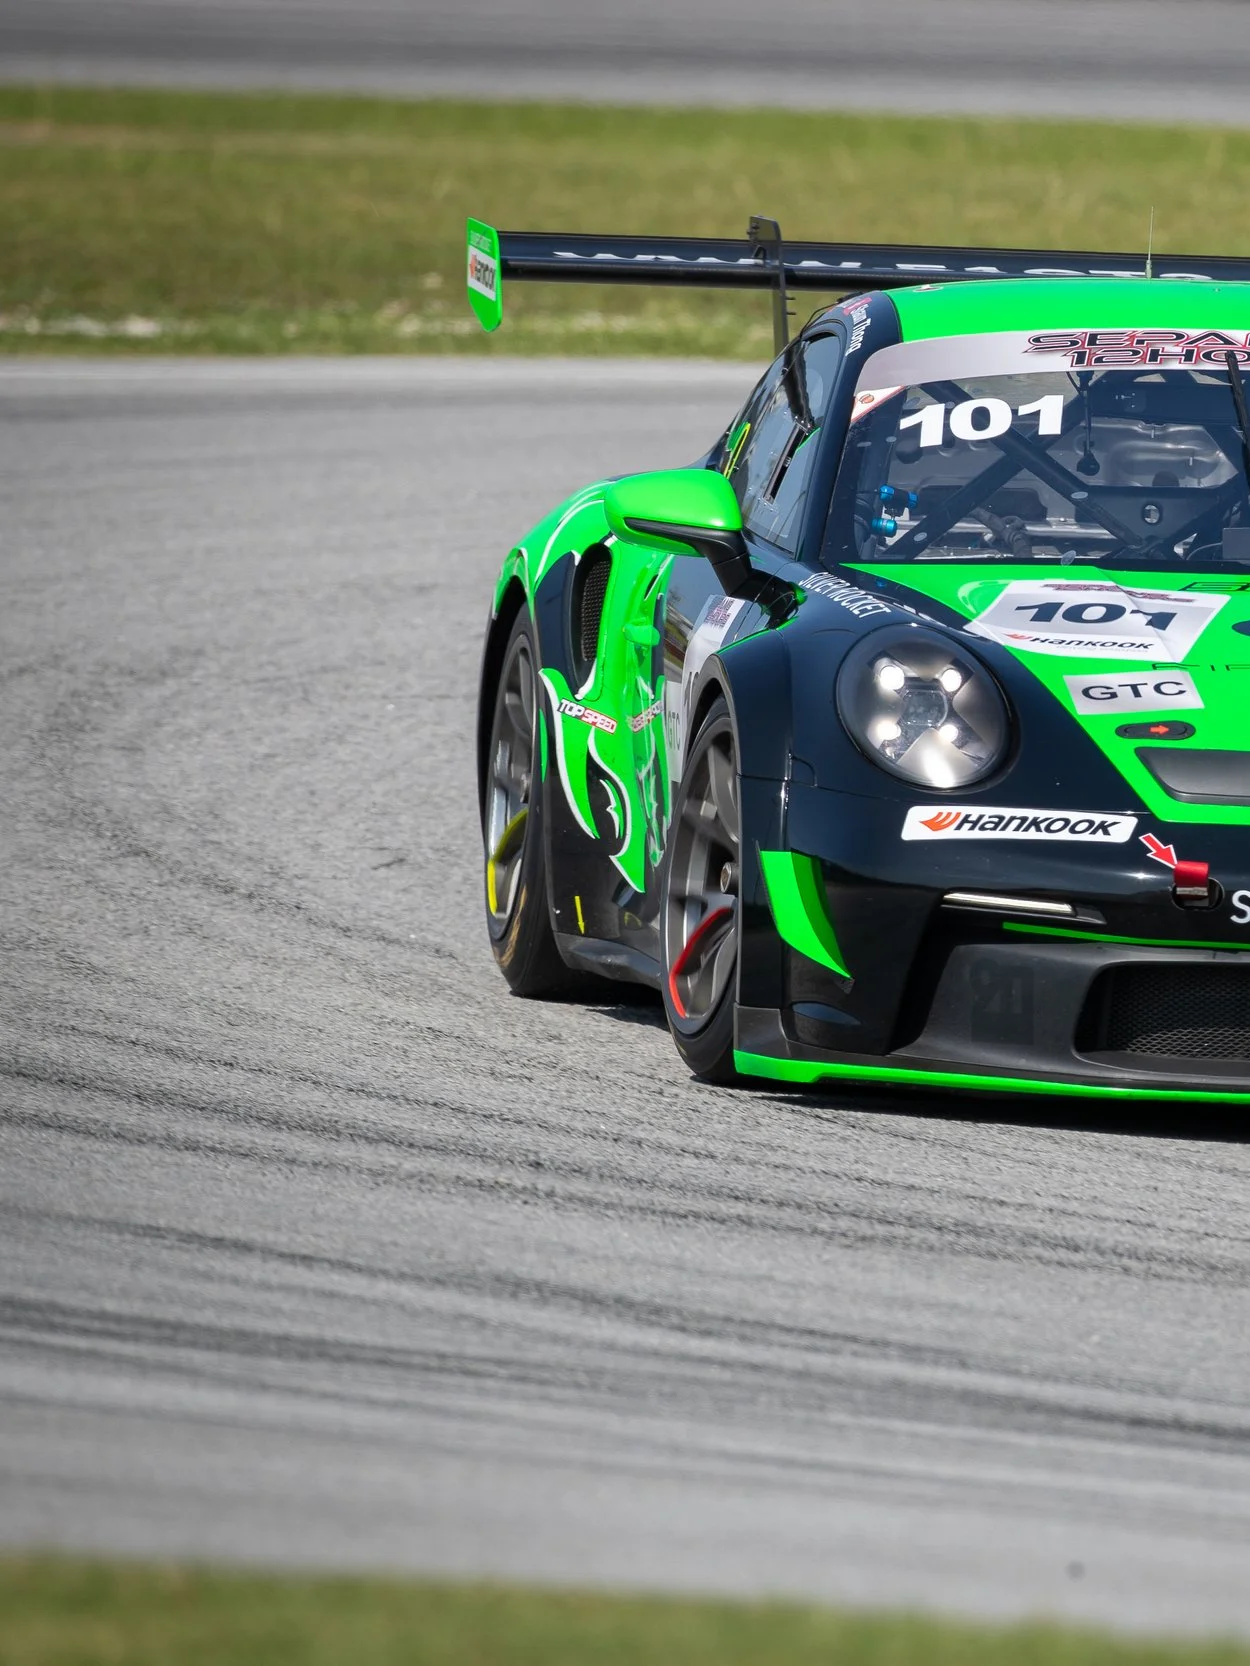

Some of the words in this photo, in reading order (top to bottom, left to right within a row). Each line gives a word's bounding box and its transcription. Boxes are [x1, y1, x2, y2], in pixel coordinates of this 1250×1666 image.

[900, 395, 1064, 448] 101
[827, 587, 892, 618] ROCKET
[1014, 601, 1178, 631] 101
[1081, 680, 1188, 701] GTC
[558, 699, 586, 717] TOP
[581, 708, 617, 734] SPEED
